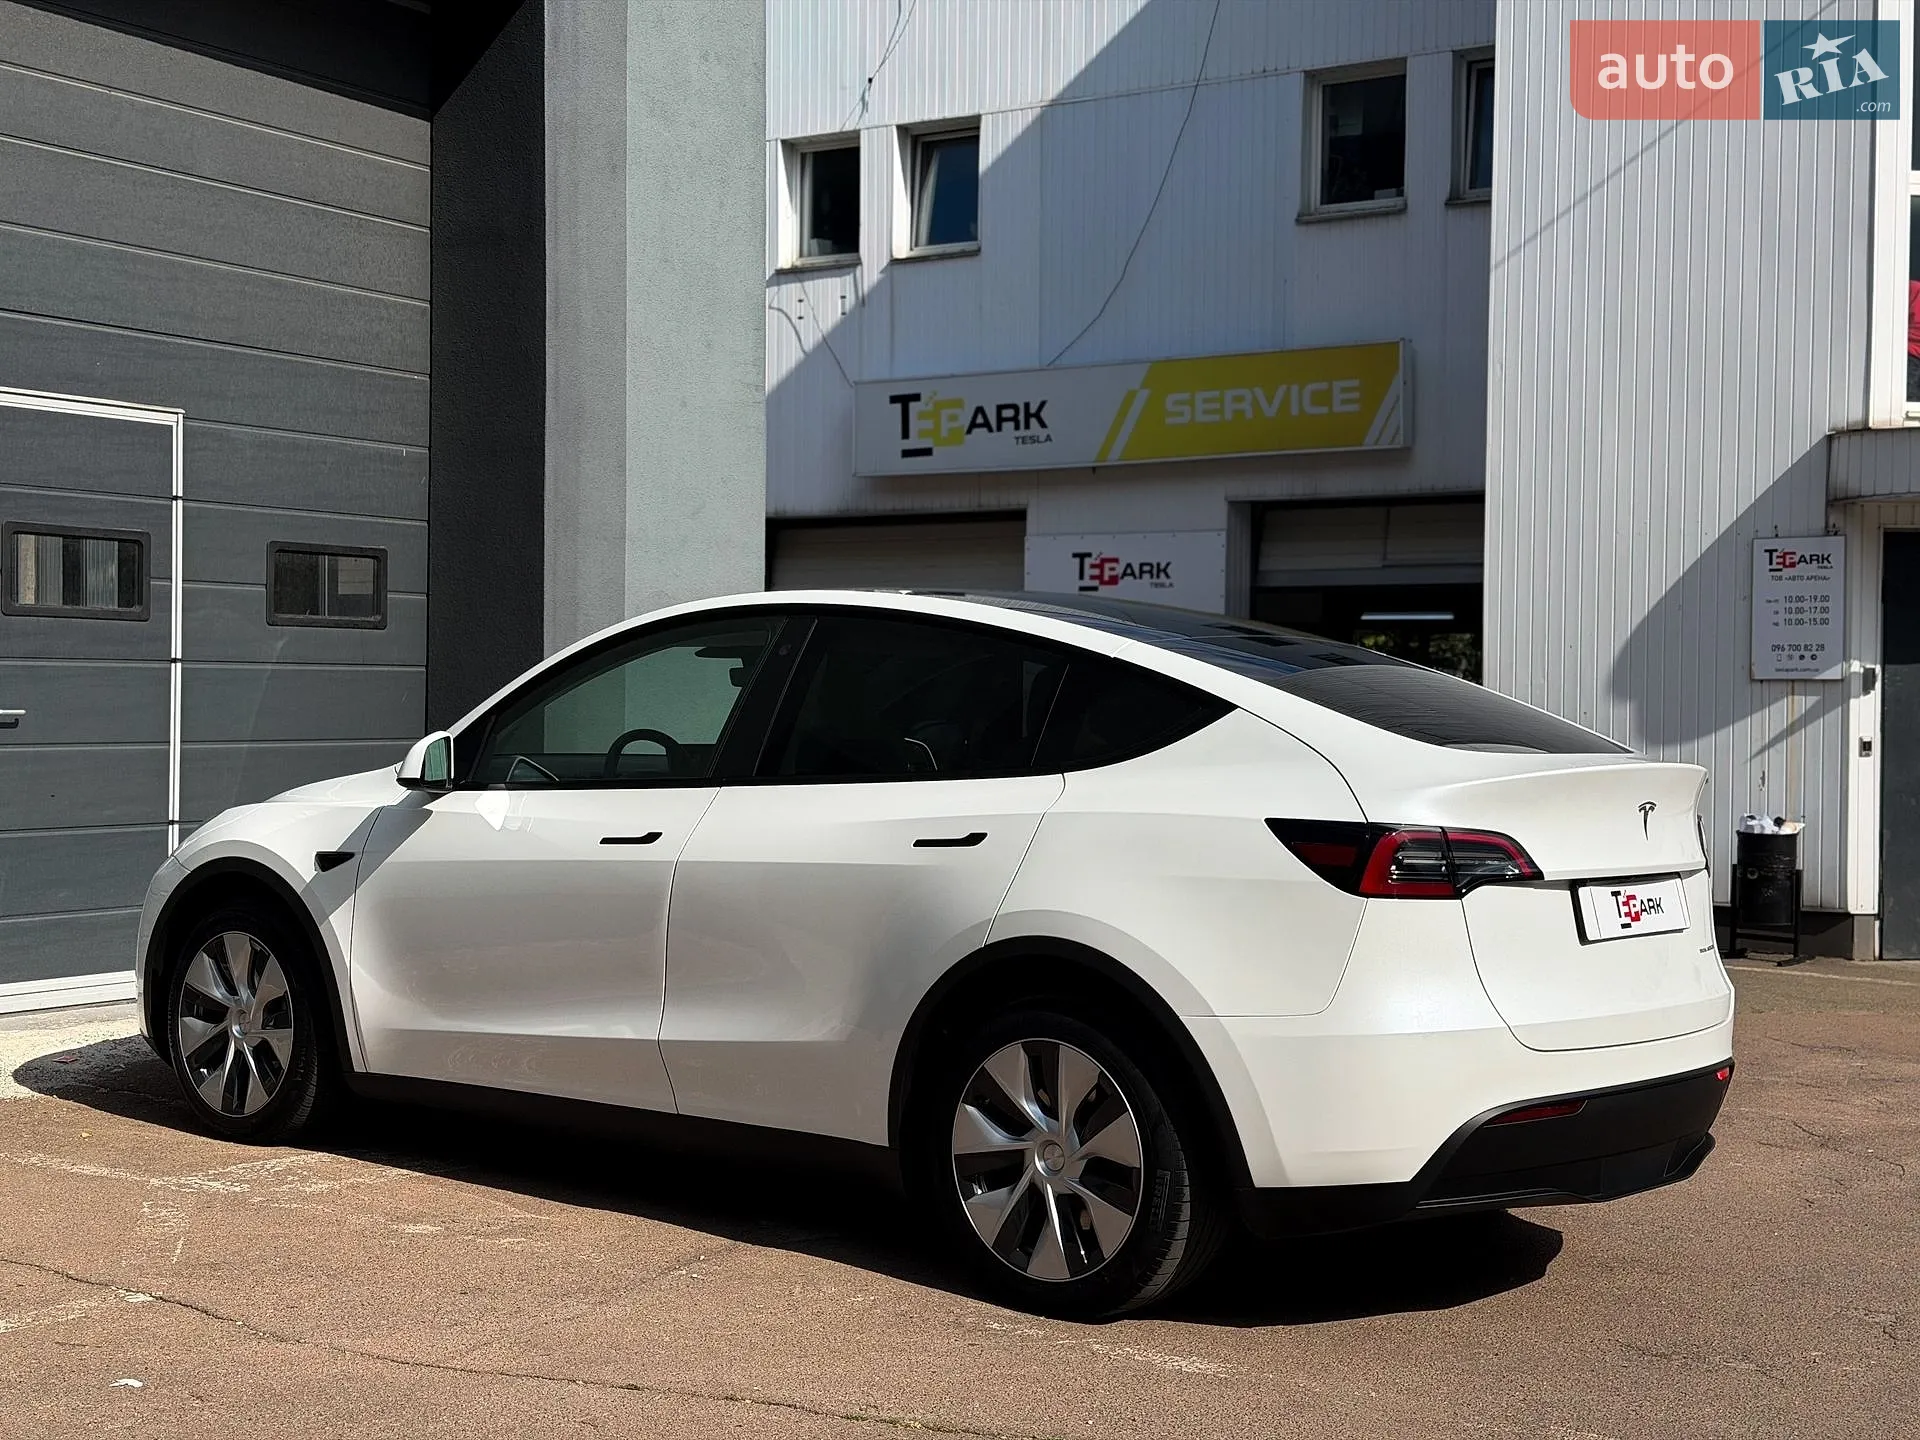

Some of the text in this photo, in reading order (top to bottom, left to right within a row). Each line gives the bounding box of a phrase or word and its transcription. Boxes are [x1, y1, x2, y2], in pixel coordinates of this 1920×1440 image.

[1165, 379, 1360, 425] SERVICE
[1014, 434, 1053, 446] TESLA
[1784, 595, 1830, 603] 10.00-19.00
[1784, 606, 1830, 615] 10.00-17.00
[1784, 618, 1829, 626] 10.00-15.00
[1771, 644, 1785, 652] 096
